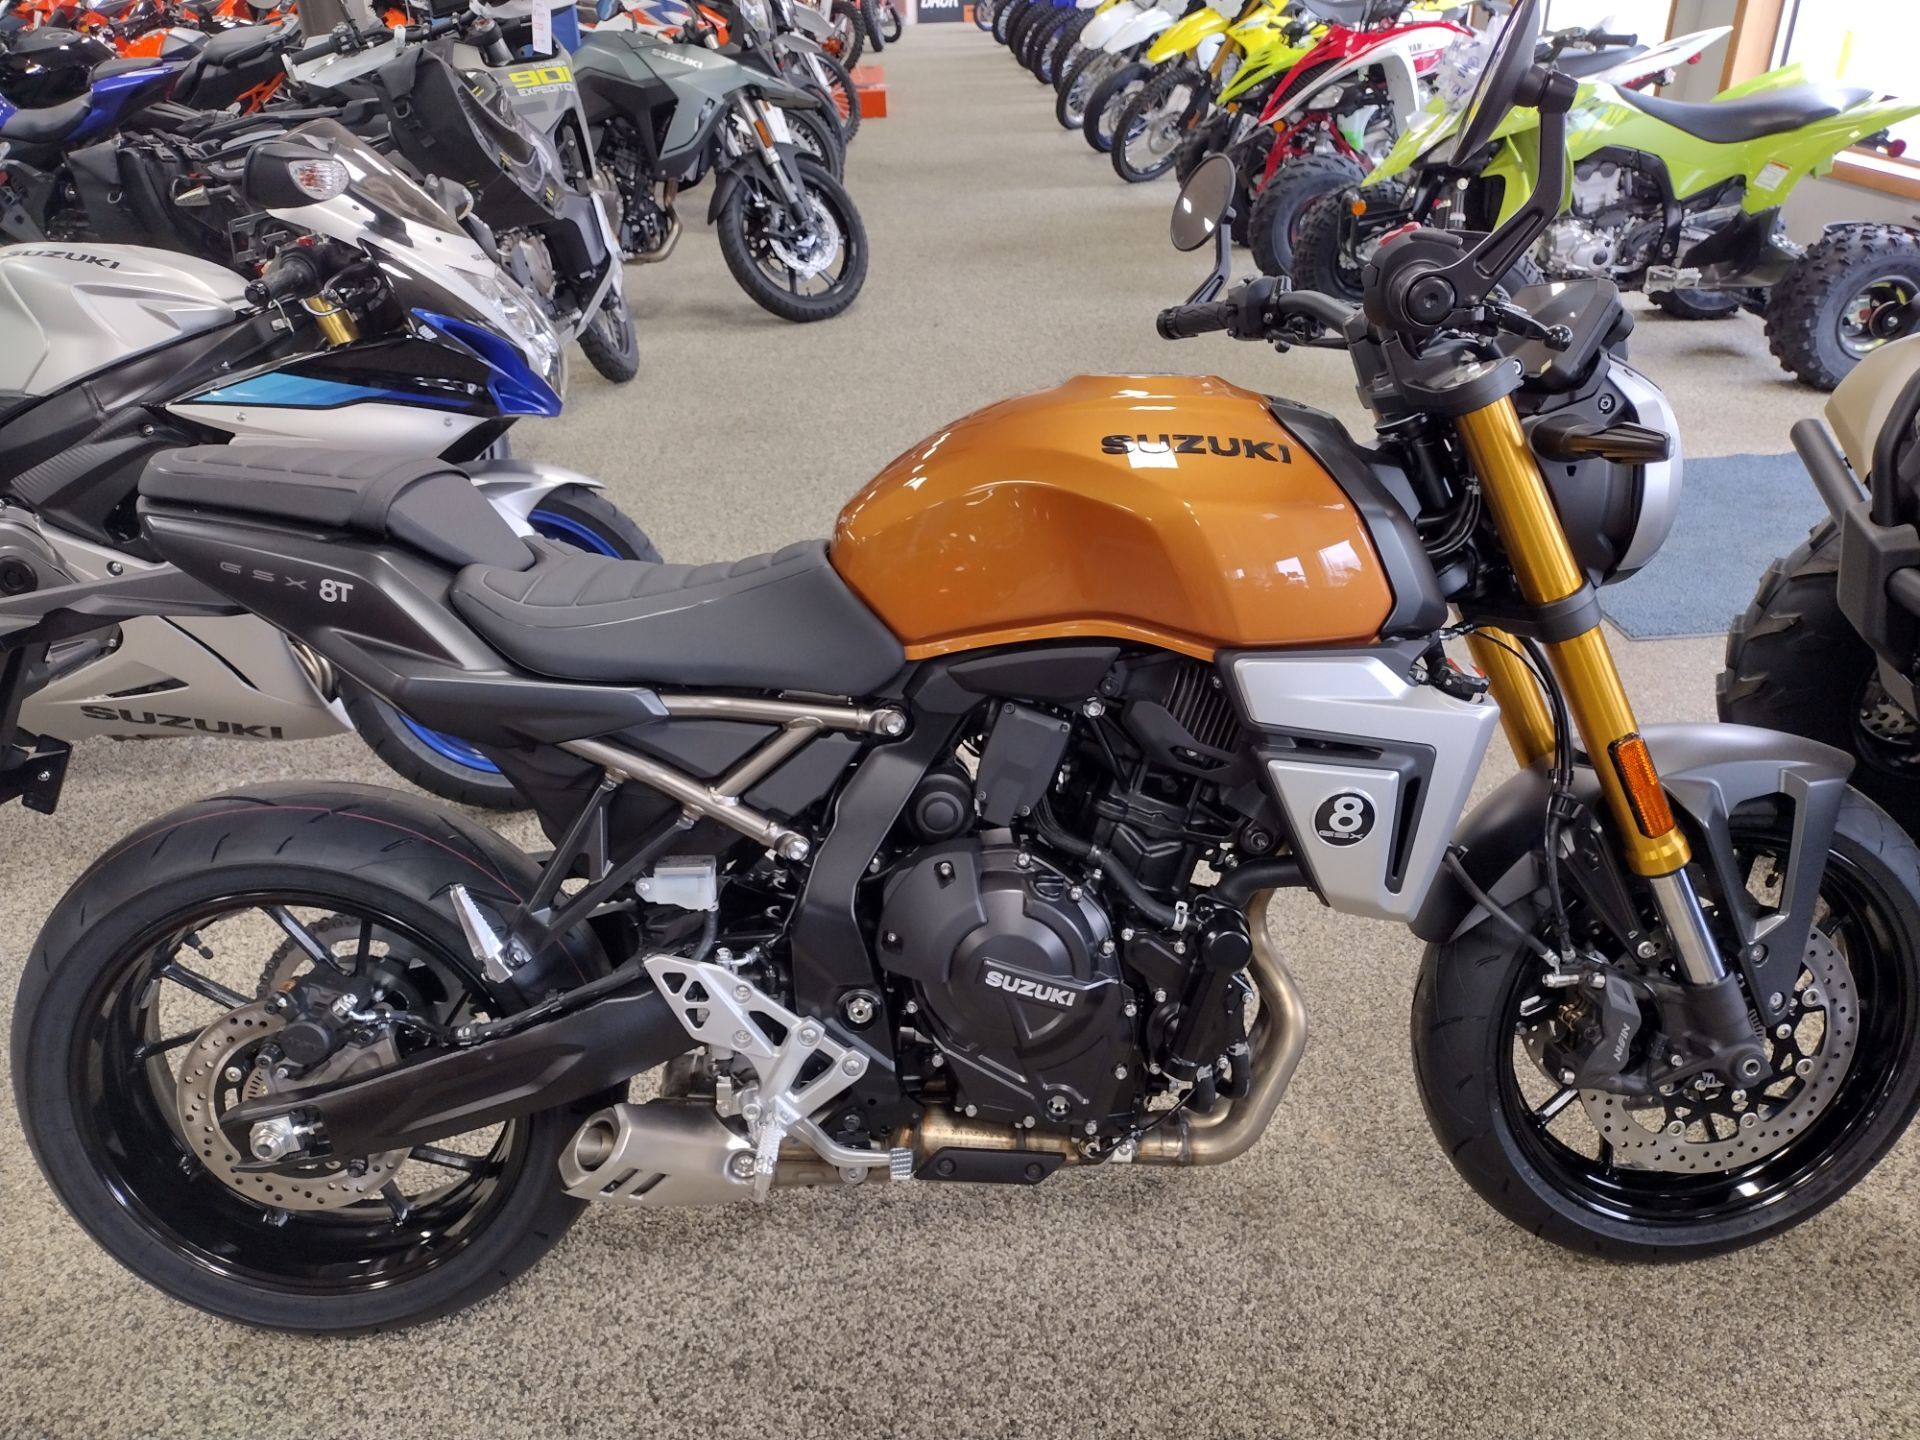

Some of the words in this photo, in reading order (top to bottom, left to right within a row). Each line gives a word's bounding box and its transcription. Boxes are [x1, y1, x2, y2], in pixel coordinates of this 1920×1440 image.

[651, 48, 703, 69] SUZUKI
[508, 66, 573, 88] 901
[2, 250, 120, 269] SUZUKI
[1101, 434, 1292, 464] SUZUKI
[219, 561, 308, 590] GSX
[319, 578, 354, 603] 8T
[80, 705, 283, 740] SUZUKI
[1328, 796, 1364, 833] 8
[984, 970, 1076, 1007] SUZUKI
